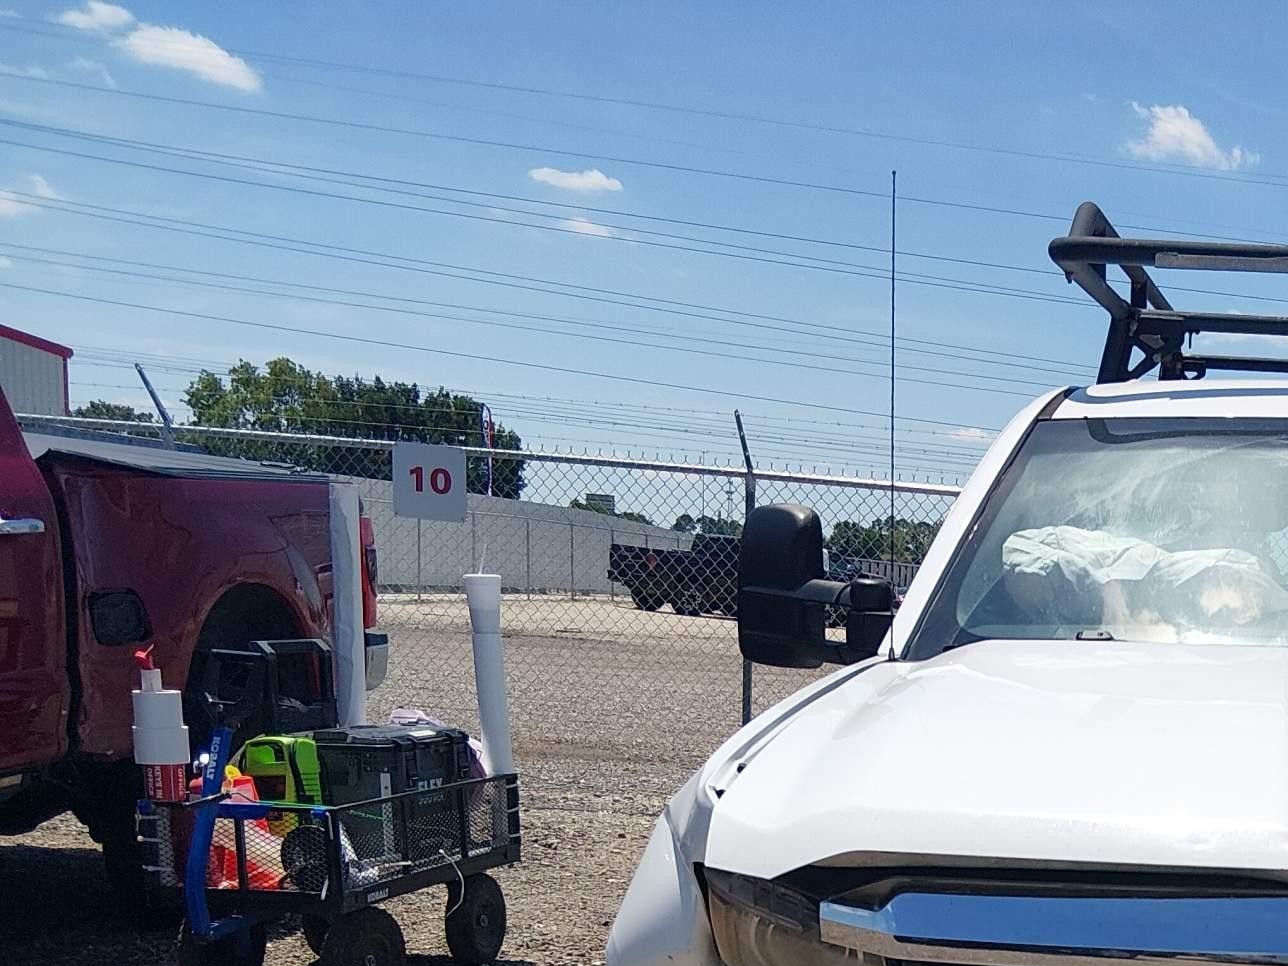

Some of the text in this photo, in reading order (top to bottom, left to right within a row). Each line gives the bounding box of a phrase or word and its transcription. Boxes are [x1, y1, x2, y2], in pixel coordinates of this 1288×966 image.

[408, 466, 452, 495] 10
[206, 736, 221, 780] KOBALT
[146, 767, 155, 796] OFFICE
